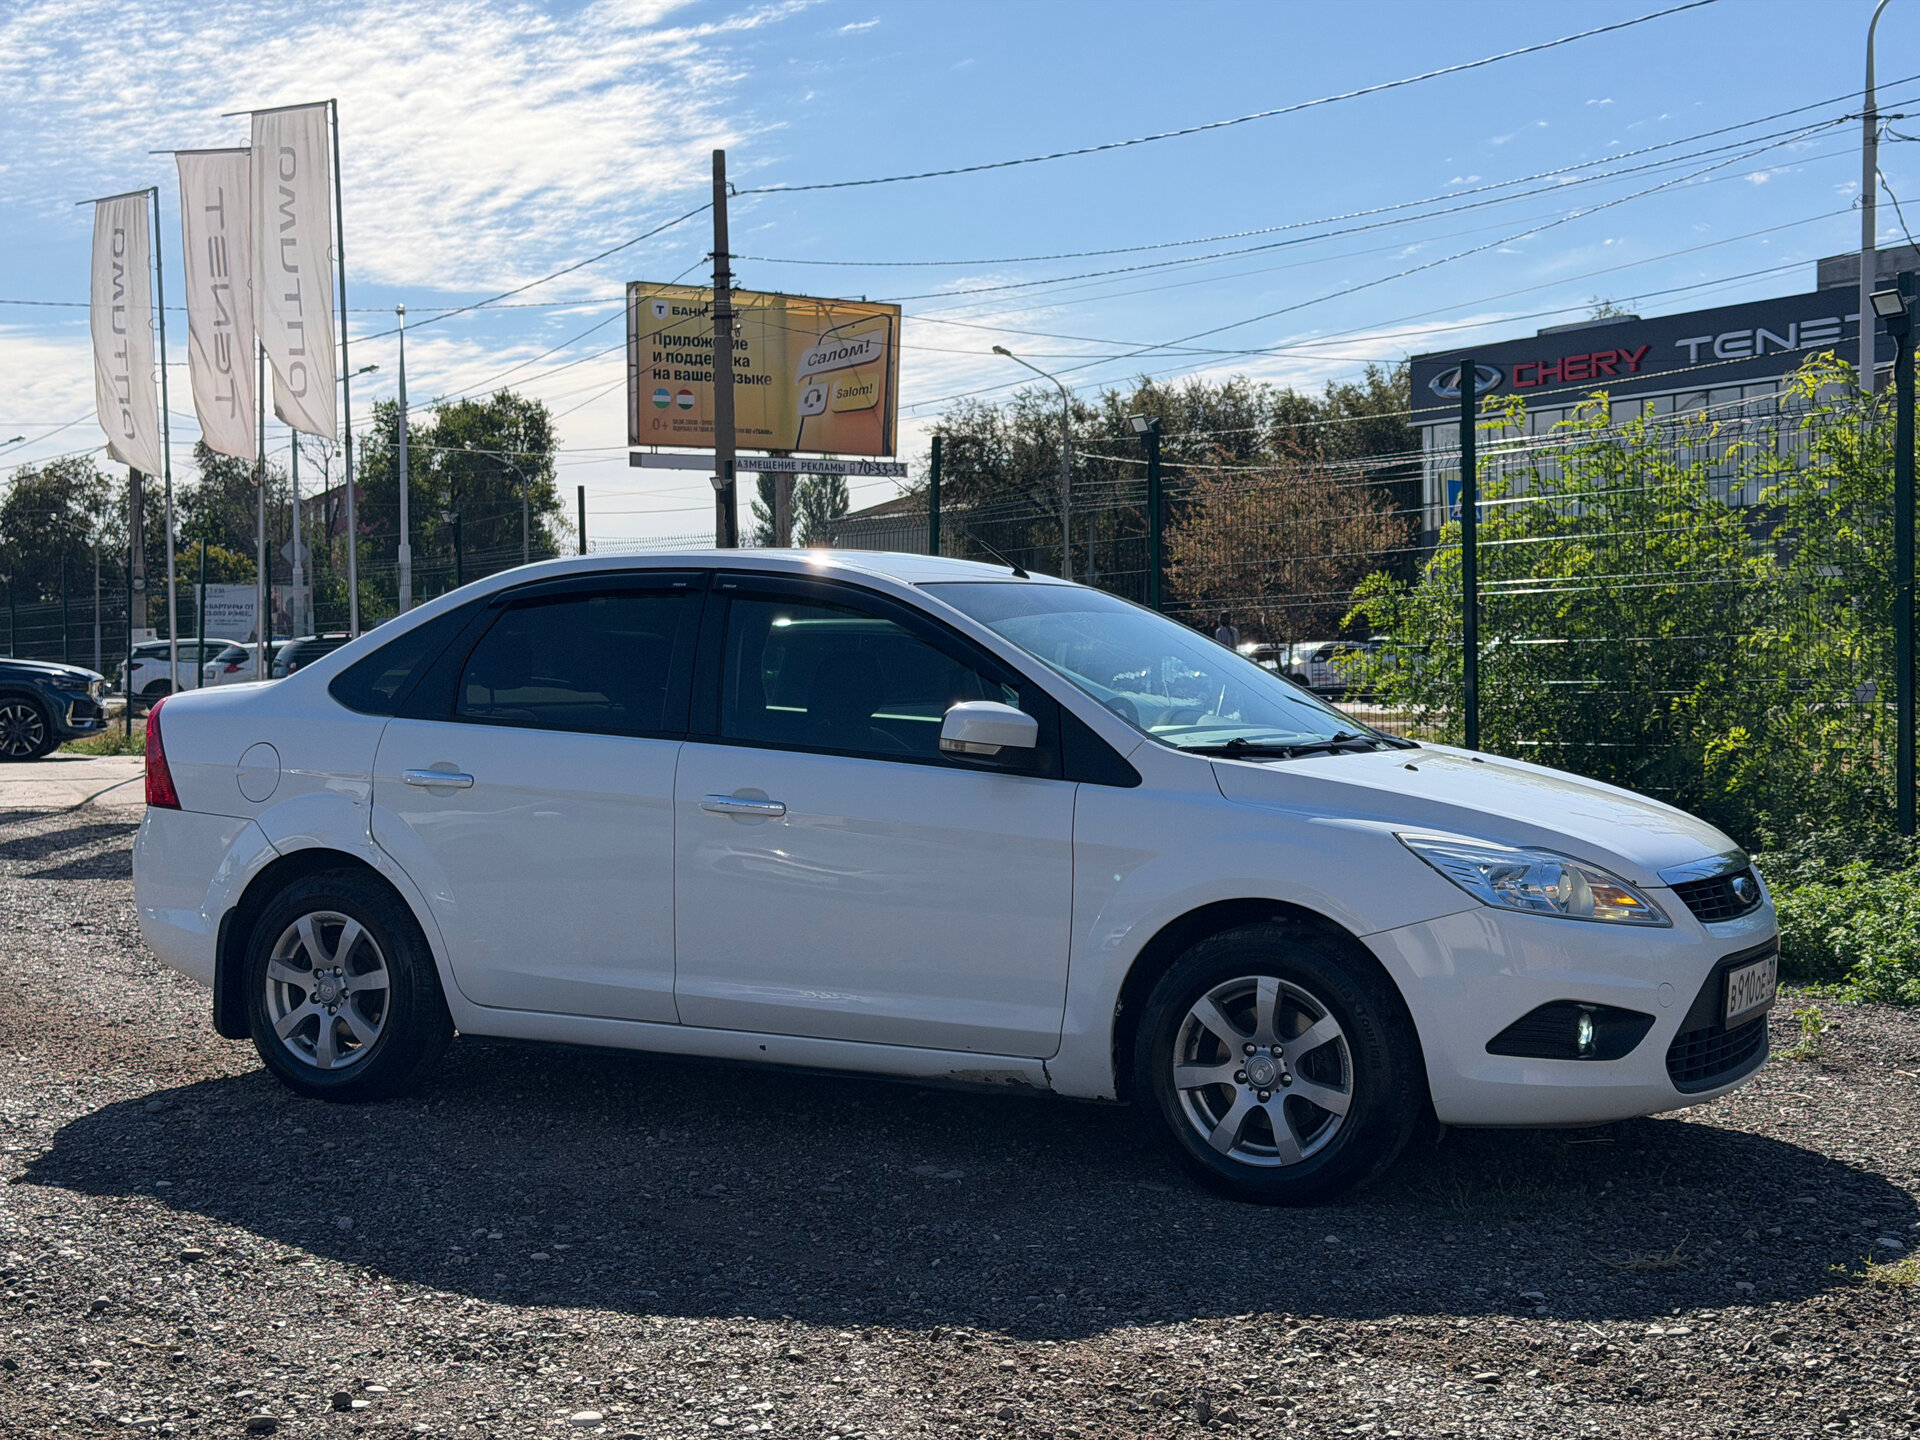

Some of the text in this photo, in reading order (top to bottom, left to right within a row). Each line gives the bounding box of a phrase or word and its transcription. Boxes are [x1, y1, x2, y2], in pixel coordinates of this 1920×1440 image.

[653, 332, 748, 350] Приложие
[666, 352, 750, 368] поддека
[807, 340, 870, 366] Салом!
[653, 368, 671, 380] на
[1513, 345, 1650, 387] CHERY
[836, 383, 873, 399] Salom!
[652, 417, 669, 431] 0+
[737, 459, 906, 475] АЗМЕЩЕНИЕ РЕКЛАМЫ 70-33-33
